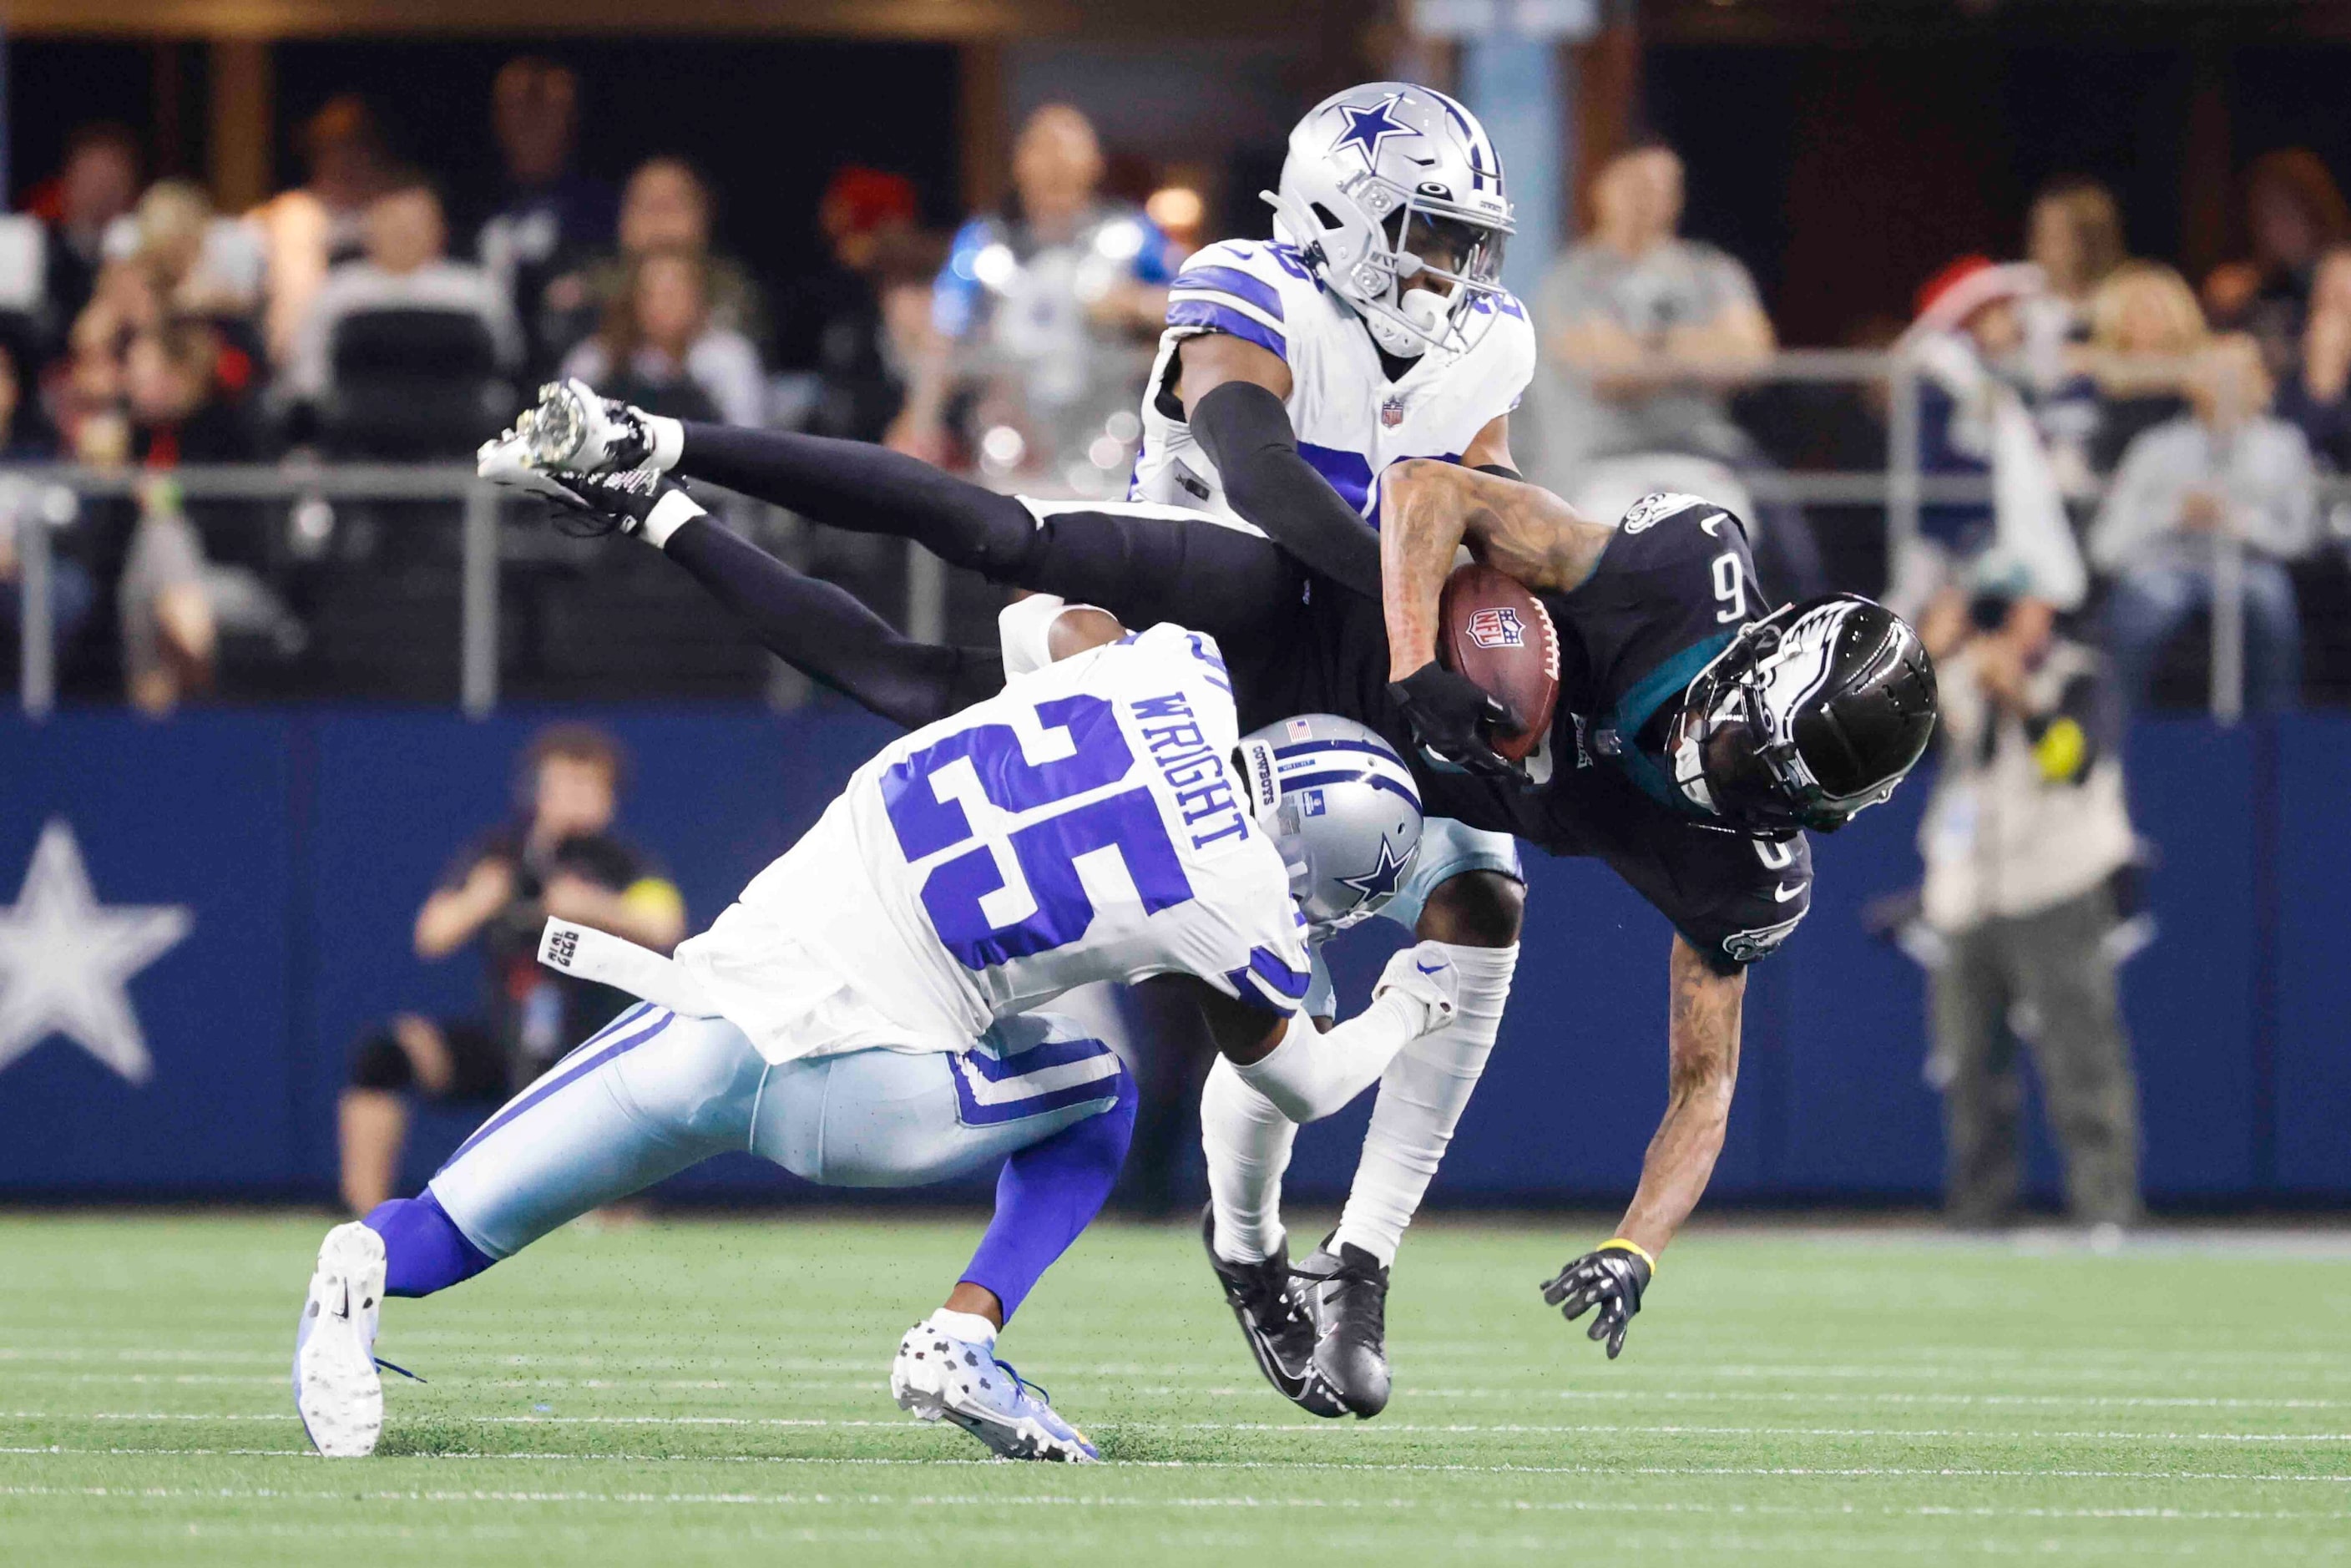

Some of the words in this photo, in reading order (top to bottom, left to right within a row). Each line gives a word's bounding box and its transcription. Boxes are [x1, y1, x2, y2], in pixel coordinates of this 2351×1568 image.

[1475, 612, 1502, 643] NFL
[1130, 690, 1249, 851] WRIGHT
[1252, 745, 1275, 807] COWBOYS
[879, 693, 1195, 971] 25
